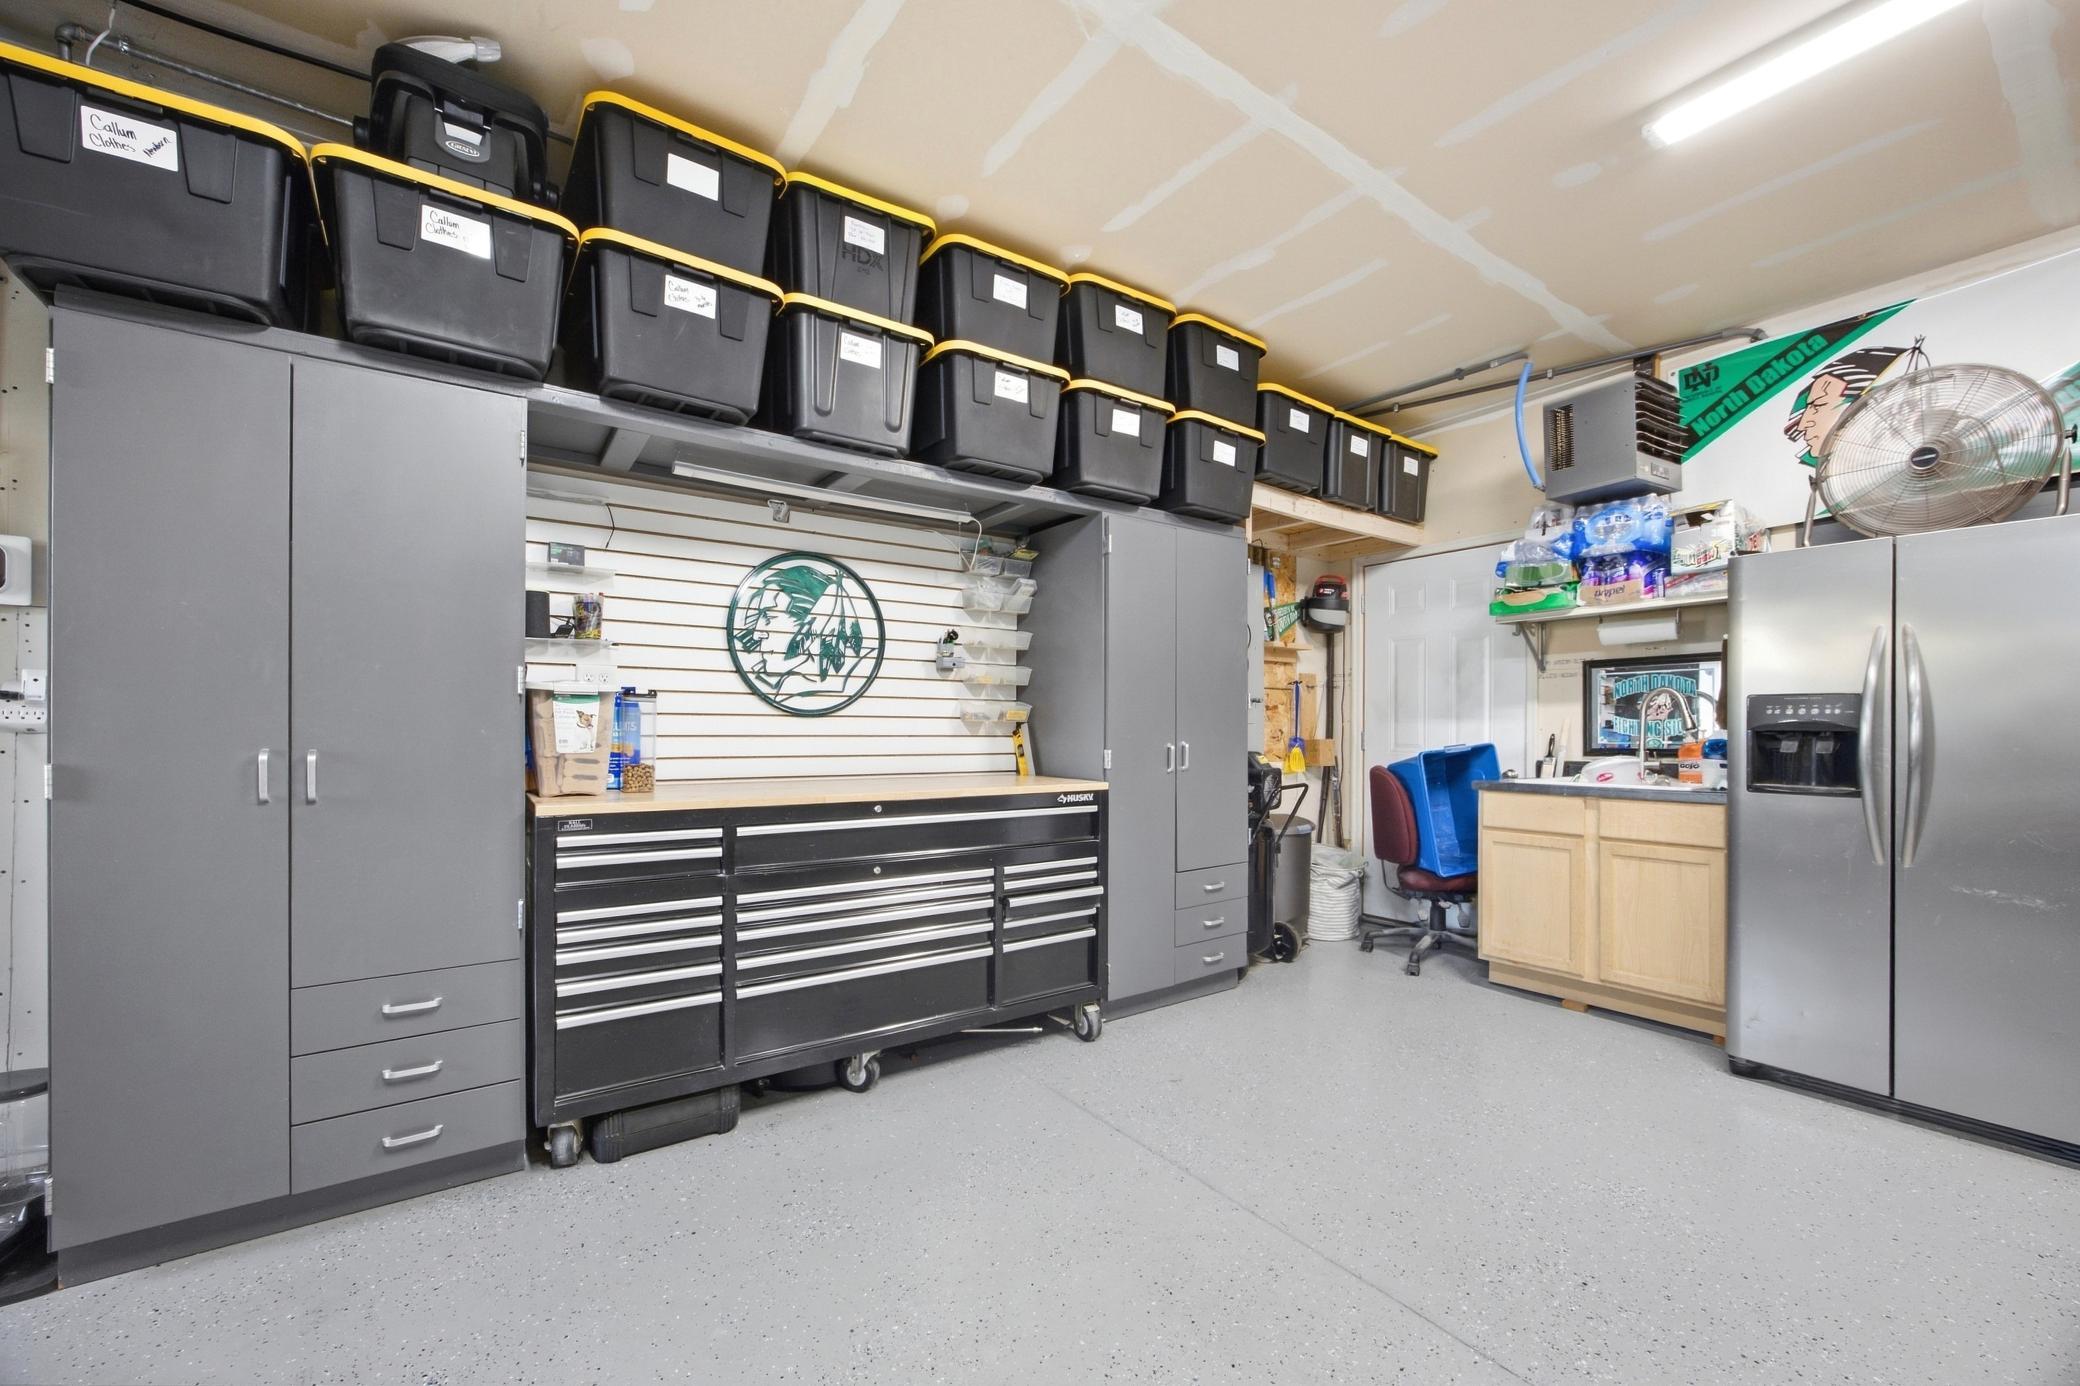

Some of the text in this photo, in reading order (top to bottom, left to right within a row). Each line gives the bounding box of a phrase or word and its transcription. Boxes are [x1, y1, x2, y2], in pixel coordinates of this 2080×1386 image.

[89, 113, 138, 141] Callum
[89, 133, 137, 153] Clothes
[429, 209, 460, 229] Callum
[425, 222, 459, 239] Clothes
[1690, 334, 1829, 437] North Dakota
[1594, 584, 1627, 599] propel
[1614, 673, 1698, 700] NORTH DAKOTA
[1066, 792, 1094, 803] HUSKY
